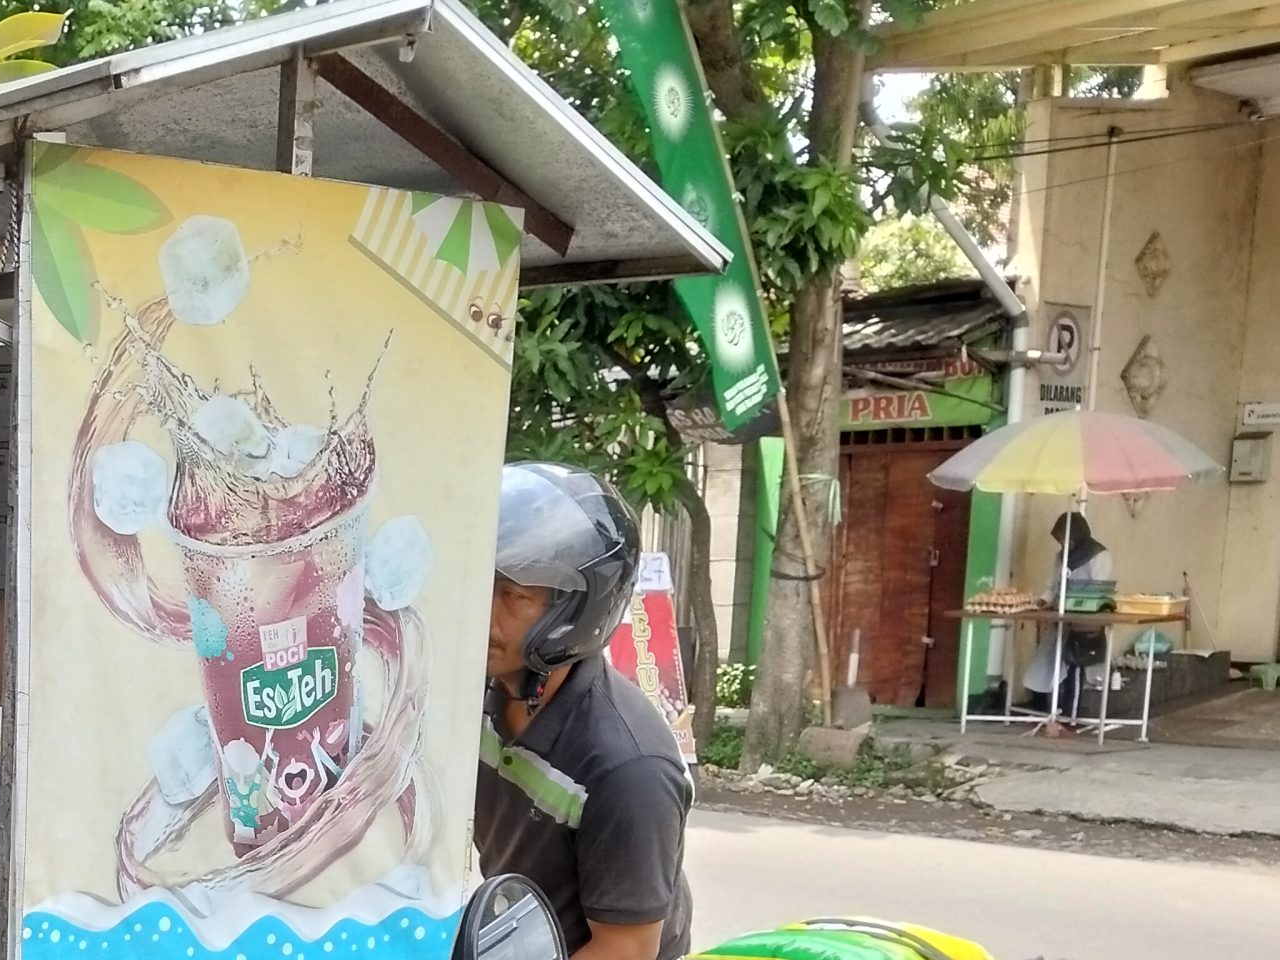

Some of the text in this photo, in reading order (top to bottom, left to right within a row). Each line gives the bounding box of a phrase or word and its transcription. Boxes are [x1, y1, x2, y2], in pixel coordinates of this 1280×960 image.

[1039, 383, 1082, 404] DILARANG
[848, 390, 933, 423] PRIA
[265, 644, 305, 669] POCI
